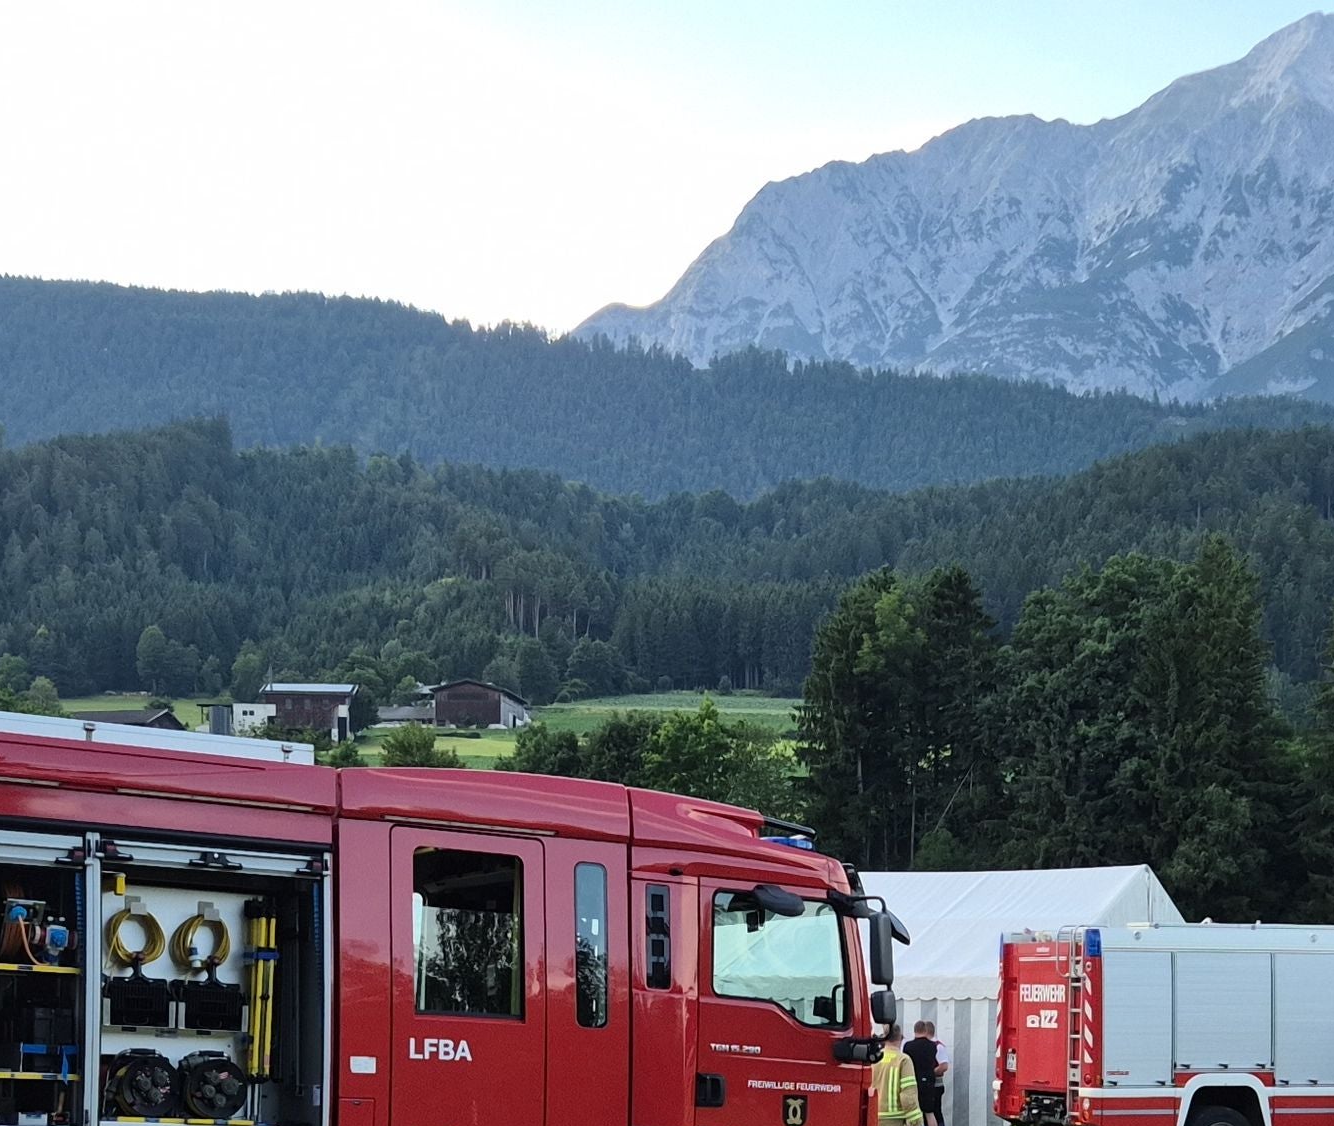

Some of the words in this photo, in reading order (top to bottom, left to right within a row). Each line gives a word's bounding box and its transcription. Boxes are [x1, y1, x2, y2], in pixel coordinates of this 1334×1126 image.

[1019, 983, 1066, 1003] FEUERWEHR
[1040, 1009, 1058, 1029] 122
[409, 1037, 473, 1062] LFBA
[748, 1080, 795, 1091] FREIWILLIGE
[796, 1082, 842, 1093] FEUERWEHR
